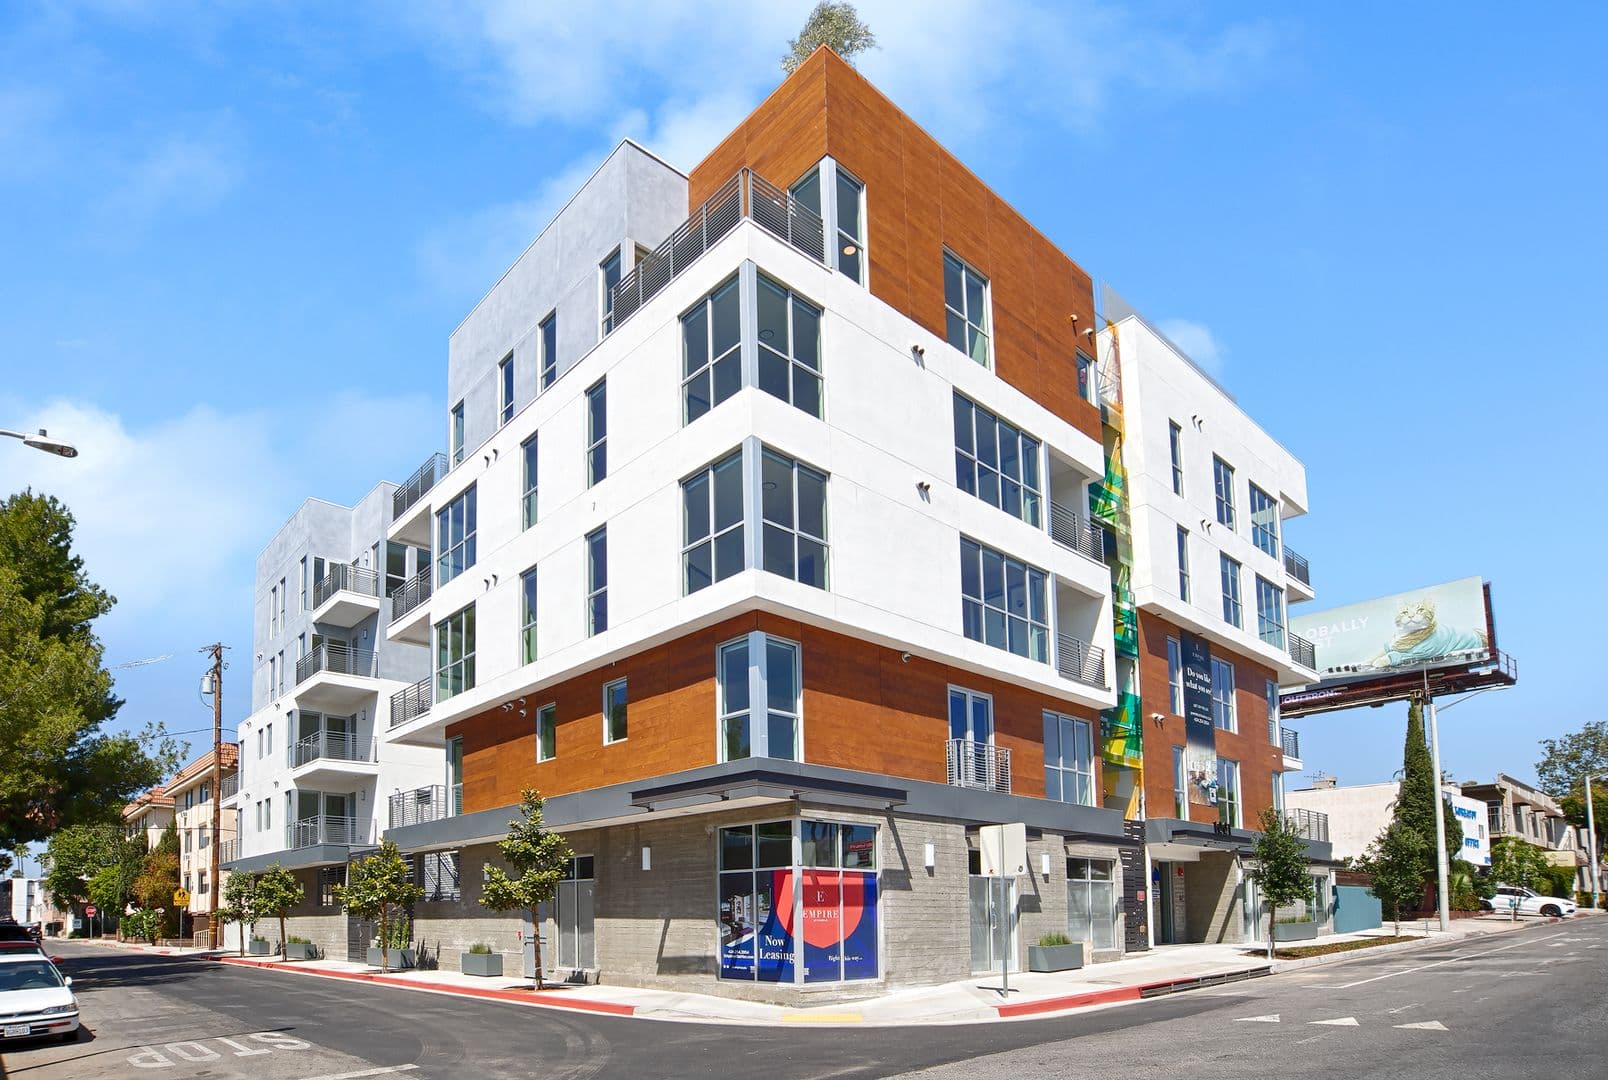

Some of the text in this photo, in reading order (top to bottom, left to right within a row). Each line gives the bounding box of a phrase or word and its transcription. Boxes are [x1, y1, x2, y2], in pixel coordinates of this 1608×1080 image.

[1187, 667, 1195, 677] Do
[1203, 673, 1211, 684] like
[1185, 679, 1198, 690] what
[1284, 689, 1337, 702] OUTFRON
[817, 891, 825, 903] E
[803, 910, 839, 919] EMPIRE
[765, 935, 785, 947] Now
[759, 948, 795, 964] Leasing
[126, 1032, 311, 1068] STOP
